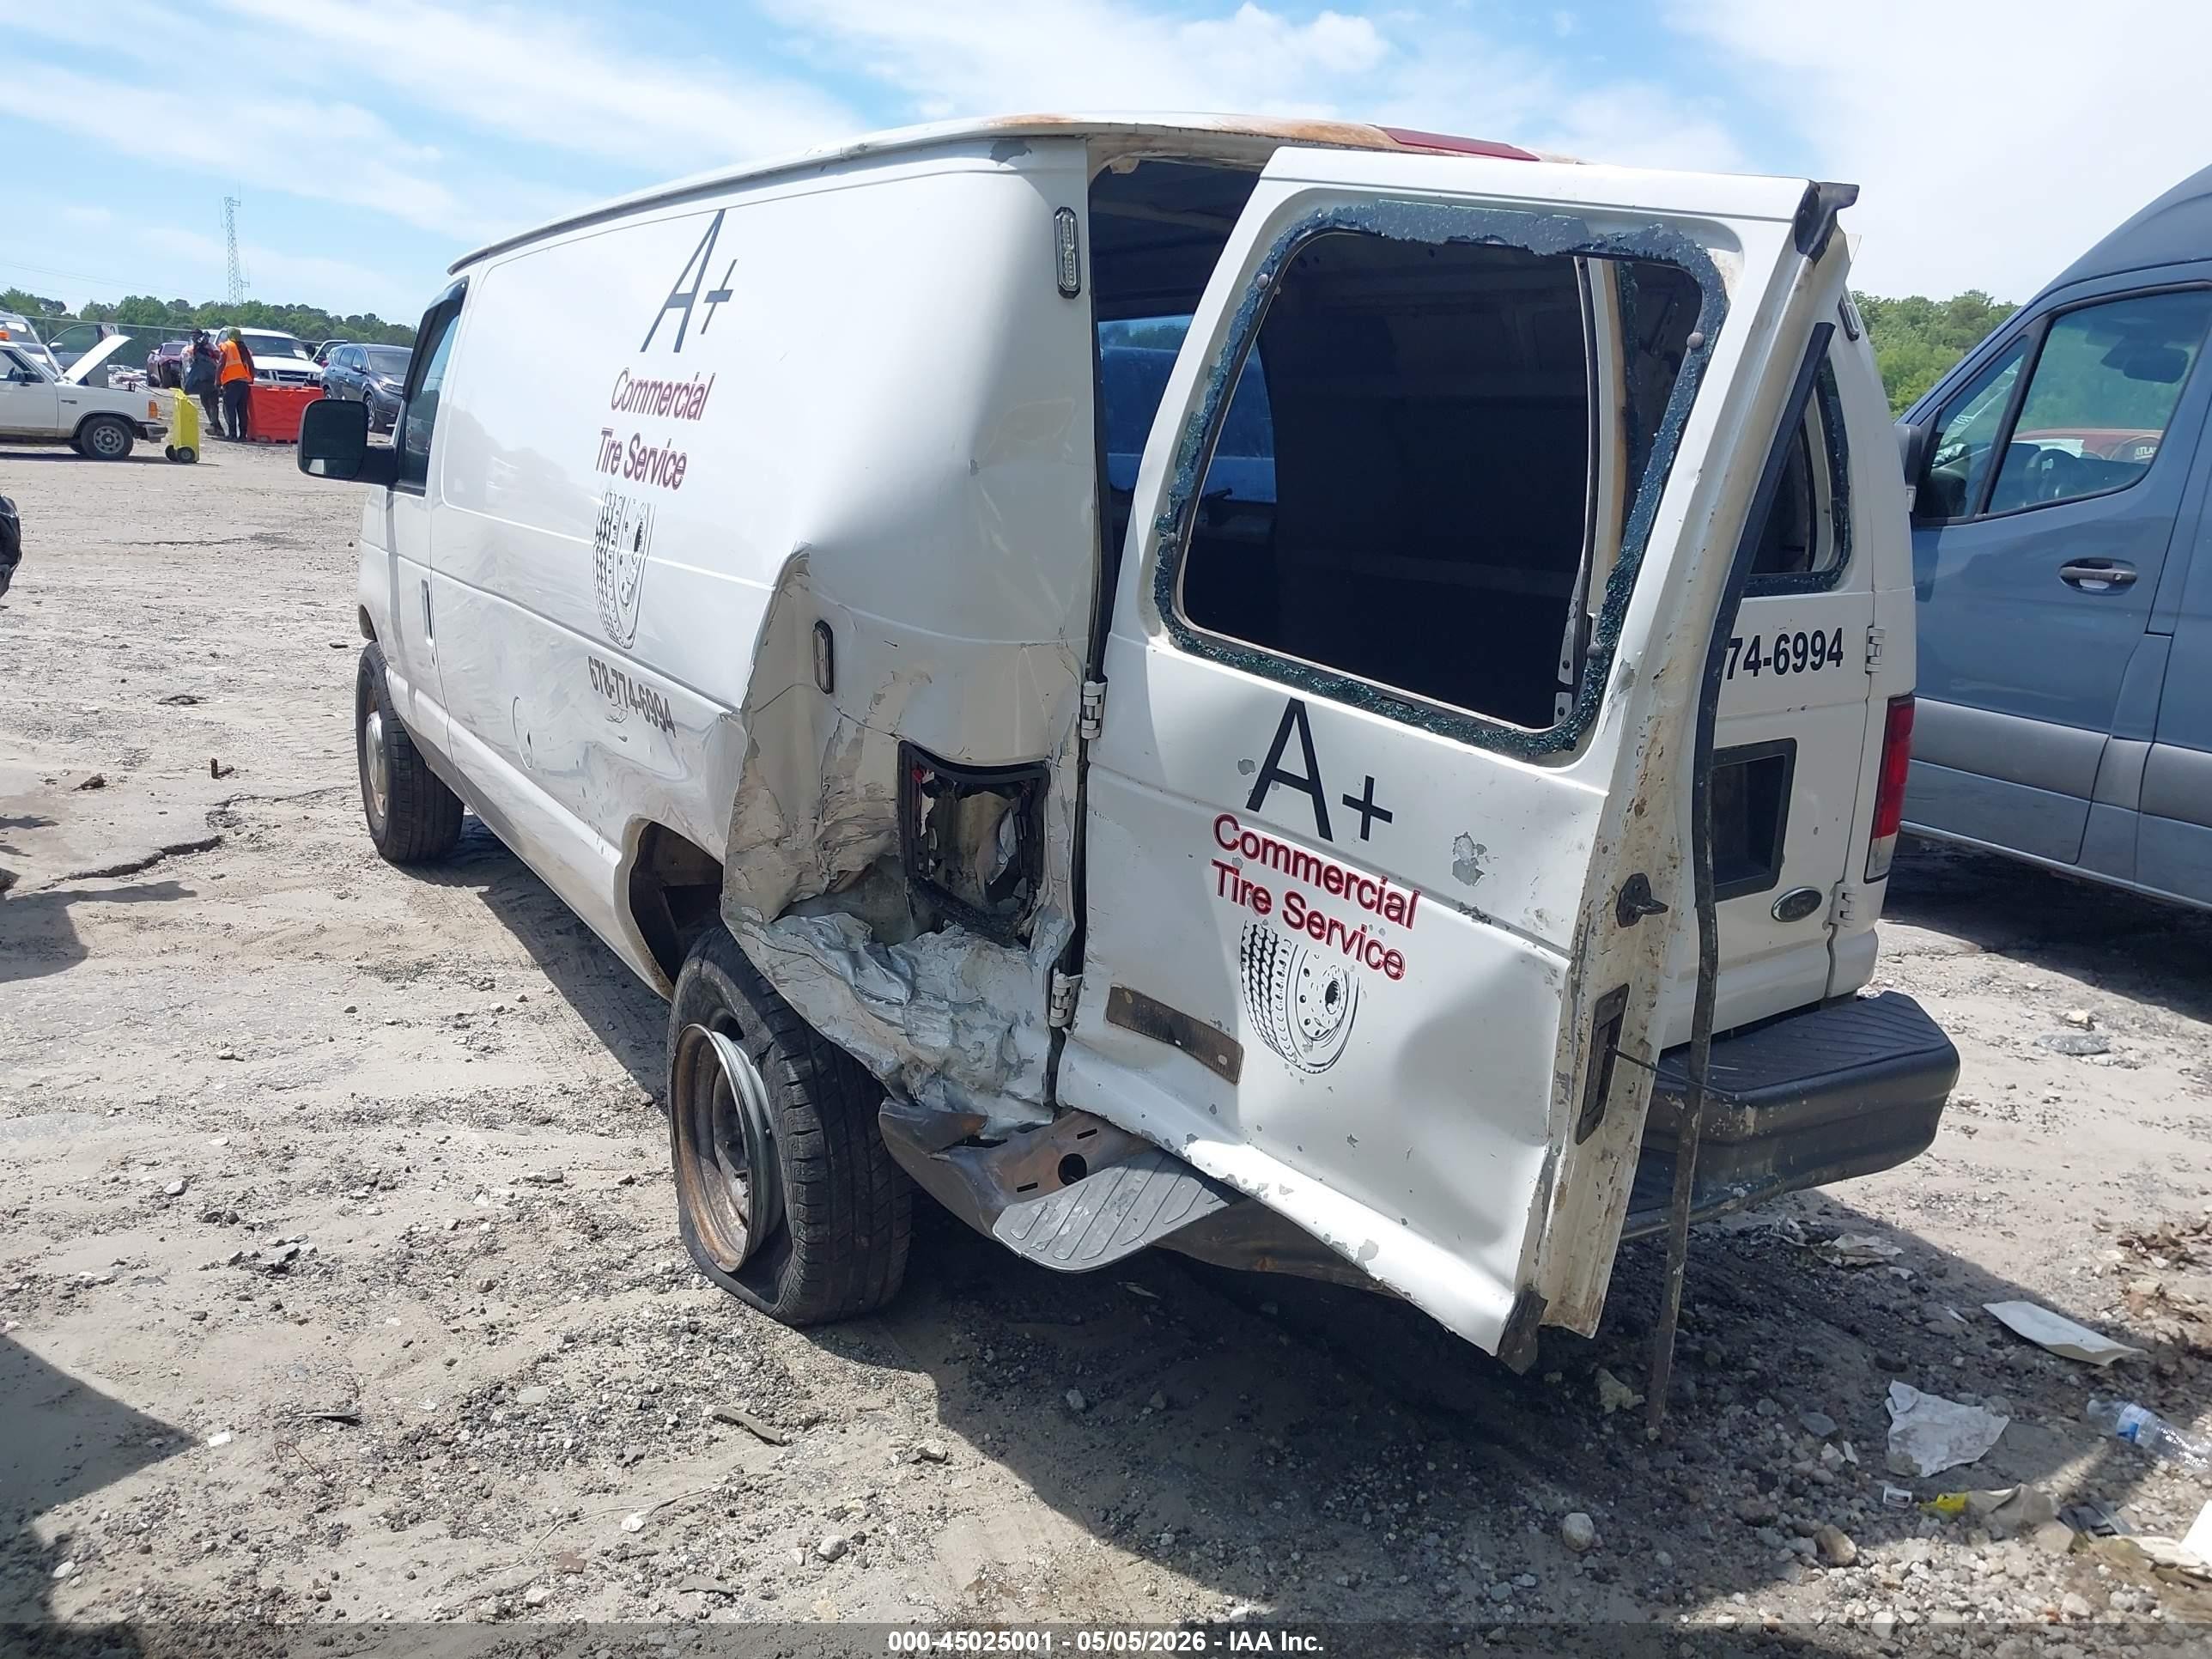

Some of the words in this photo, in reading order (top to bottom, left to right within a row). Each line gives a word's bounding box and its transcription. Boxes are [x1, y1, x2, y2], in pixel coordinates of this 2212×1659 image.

[640, 209, 738, 353] A+
[611, 367, 715, 421] Commercial
[596, 427, 623, 476] Tire
[623, 432, 687, 490] Service
[588, 655, 677, 738] 678-774-6994
[1726, 627, 1844, 680] 74-6994
[1245, 696, 1394, 843] A+
[1211, 859, 1273, 915] Tire
[1281, 890, 1406, 981] Service
[1212, 813, 1421, 930] Commercial
